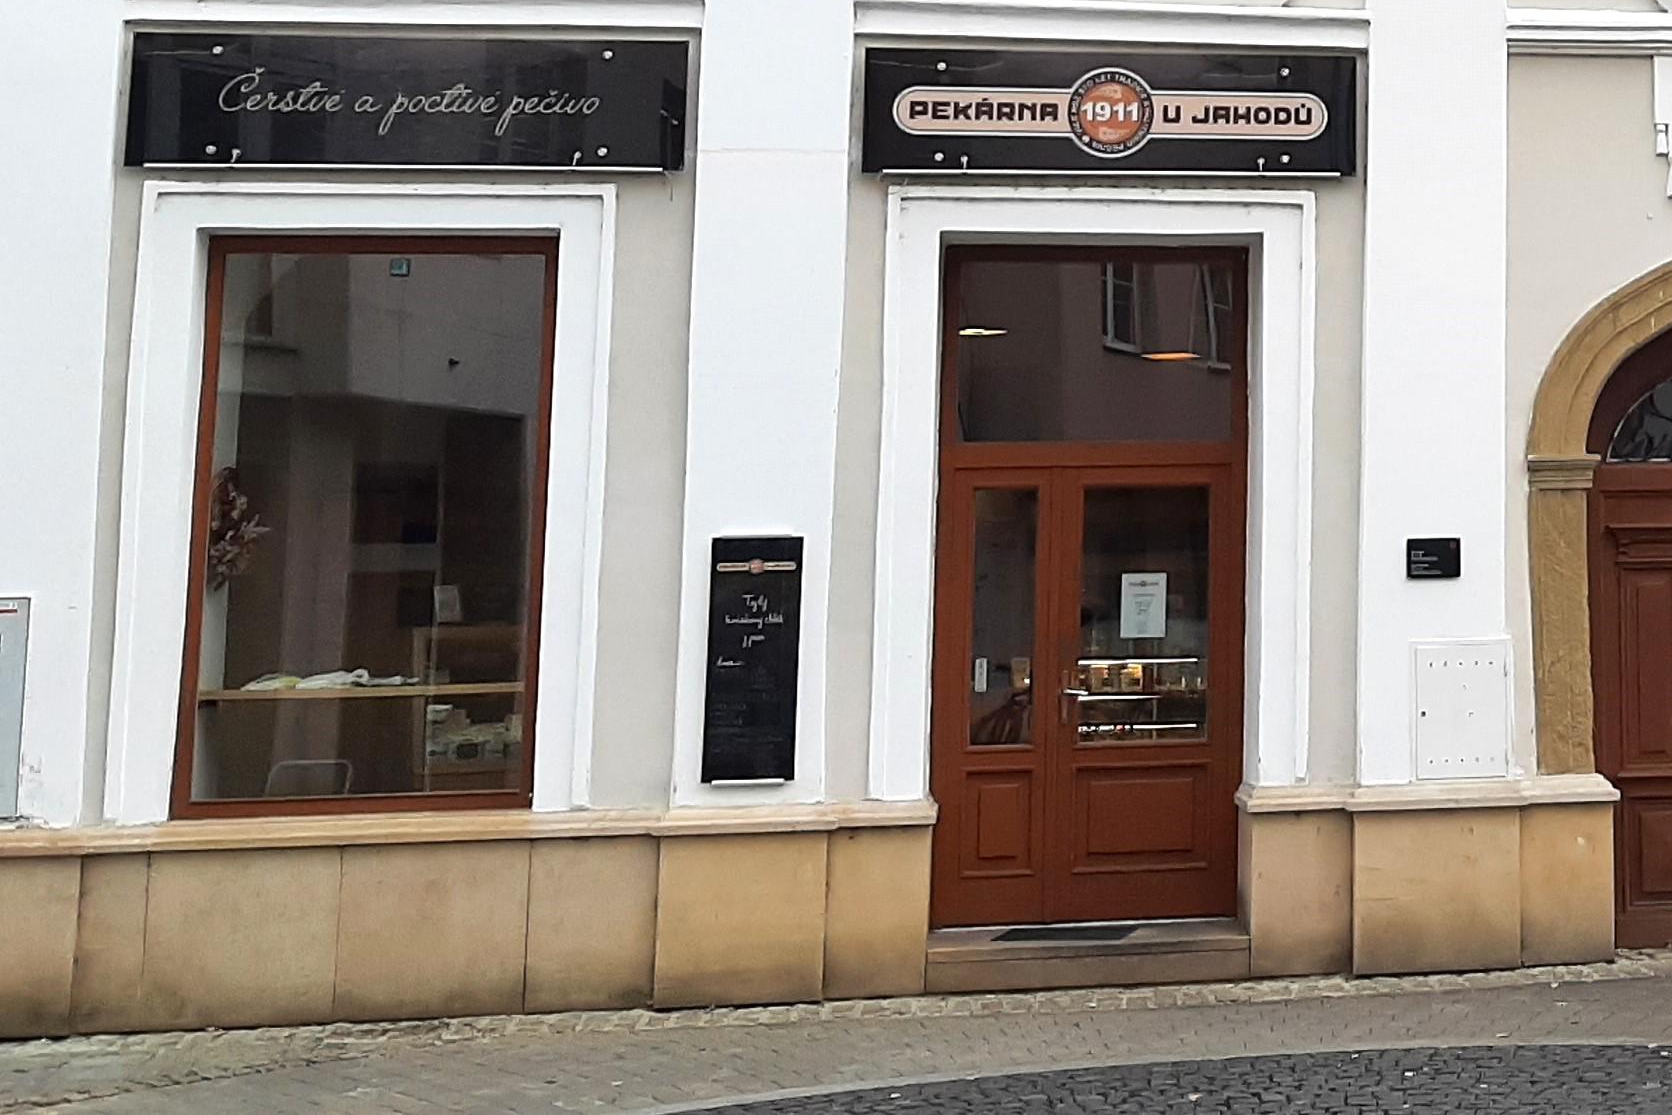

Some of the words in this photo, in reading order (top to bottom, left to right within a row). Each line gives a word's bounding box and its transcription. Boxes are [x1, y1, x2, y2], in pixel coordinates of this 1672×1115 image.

[218, 67, 344, 113] Čerstvé
[354, 96, 381, 112] a
[378, 82, 498, 135] poctivé
[495, 90, 599, 136] pečivo
[909, 98, 1059, 122] PEKÁRNA
[1081, 101, 1139, 122] 1911
[1163, 104, 1182, 124] U
[1192, 102, 1312, 126] JAHODŮ
